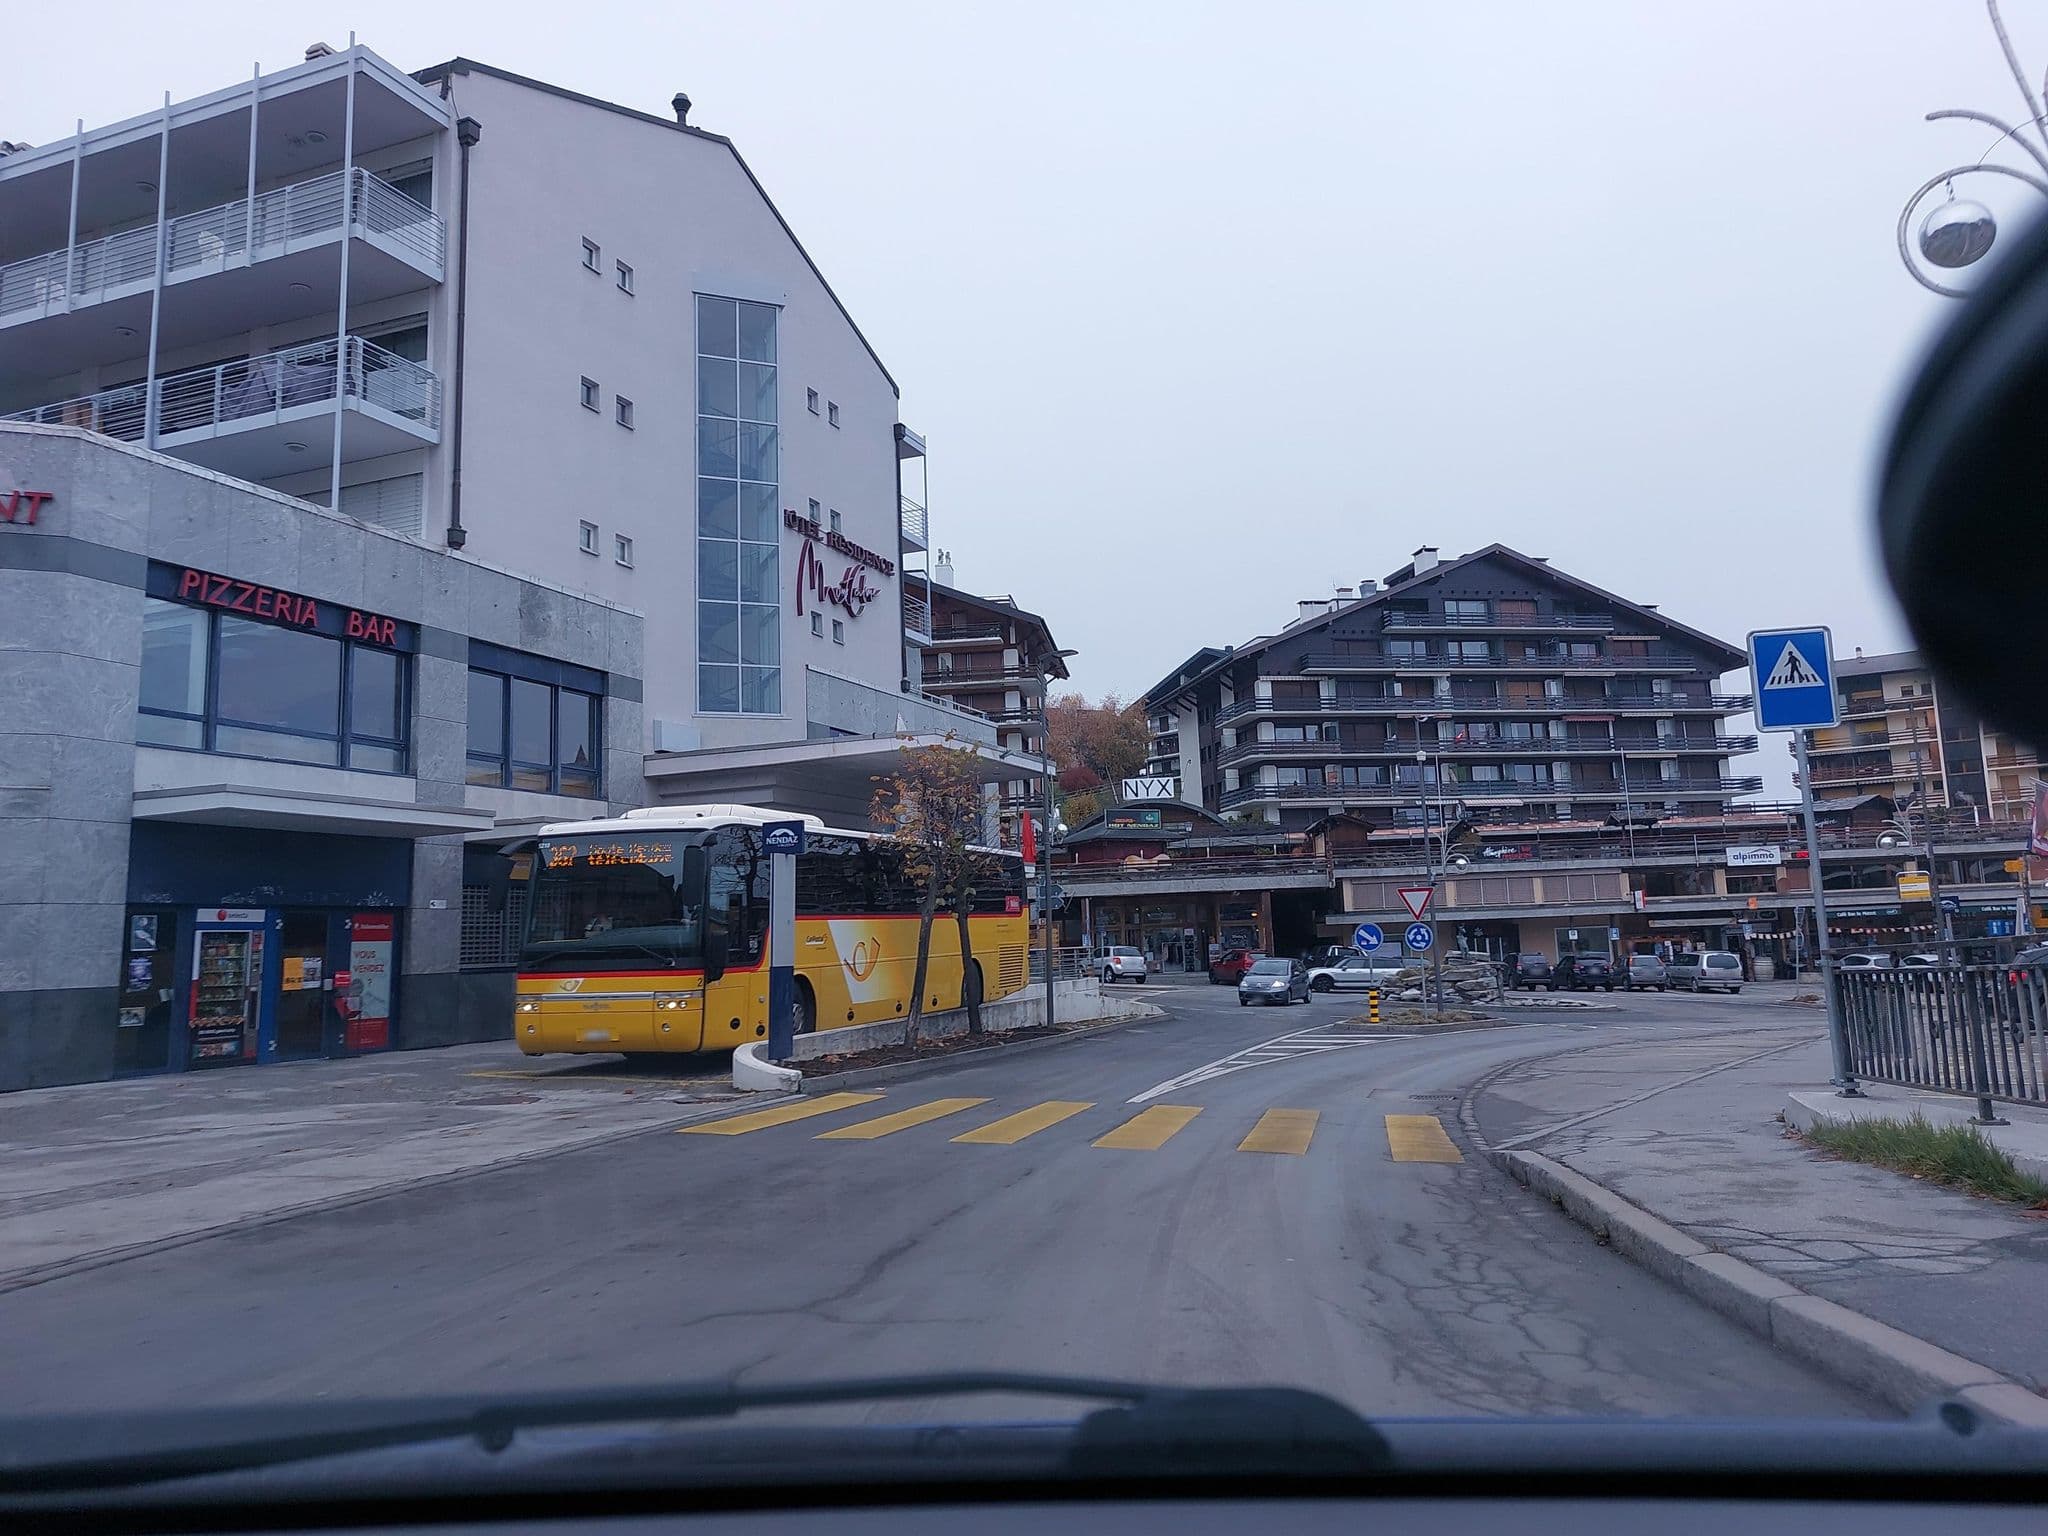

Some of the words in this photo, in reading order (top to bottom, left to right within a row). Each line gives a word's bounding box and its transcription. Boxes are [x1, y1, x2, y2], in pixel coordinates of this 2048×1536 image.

[179, 568, 319, 628] PIZZERIA
[346, 610, 397, 646] BAR
[1124, 779, 1172, 798] NYX
[765, 835, 799, 845] NENDAZ
[1732, 851, 1775, 864] alpimmo
[352, 963, 385, 973] VENDEZ
